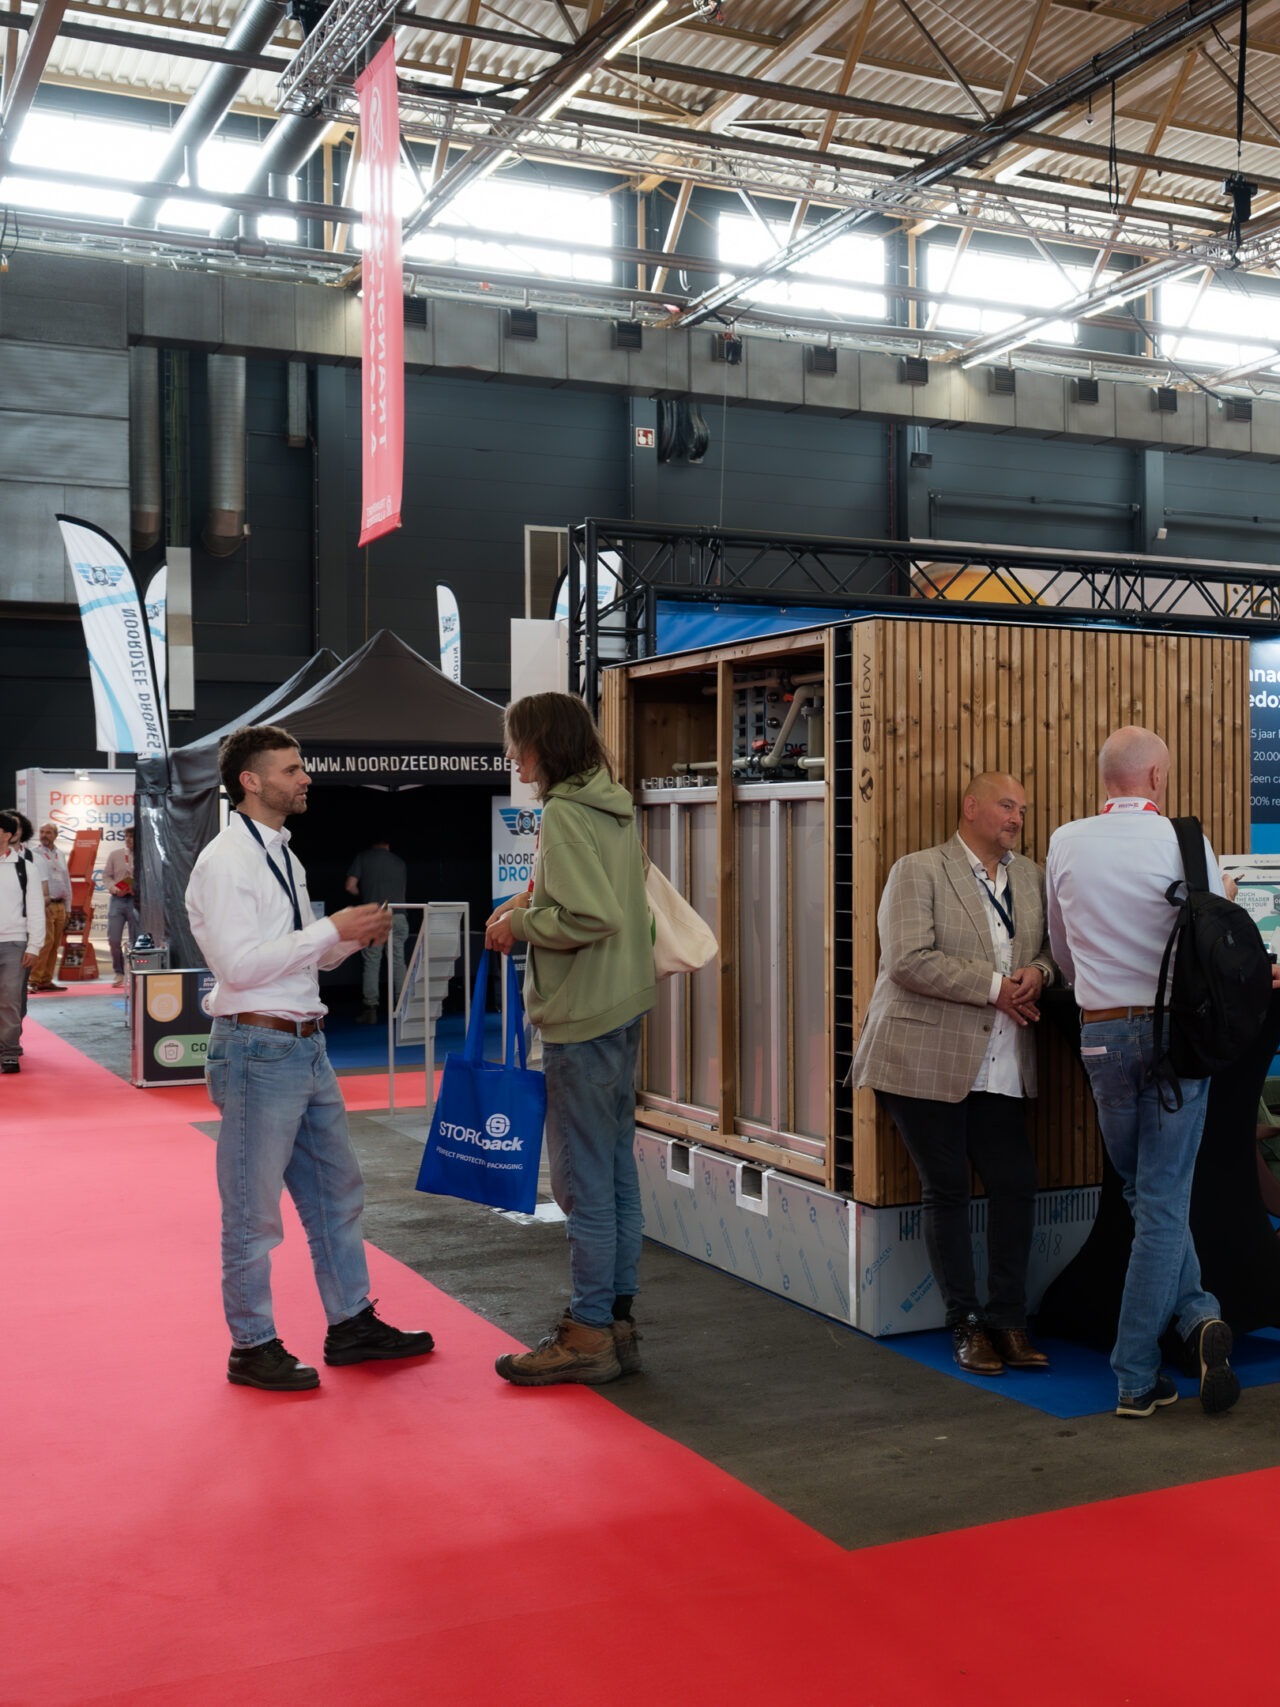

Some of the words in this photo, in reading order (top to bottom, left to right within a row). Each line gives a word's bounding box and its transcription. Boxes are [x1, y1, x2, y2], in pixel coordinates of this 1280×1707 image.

[1258, 729, 1277, 741] jaar
[304, 755, 511, 772] WWW.NOORDZEEDRONES.BE
[1250, 796, 1270, 806] 00%
[85, 809, 134, 826] Supp
[498, 866, 533, 881] DRO
